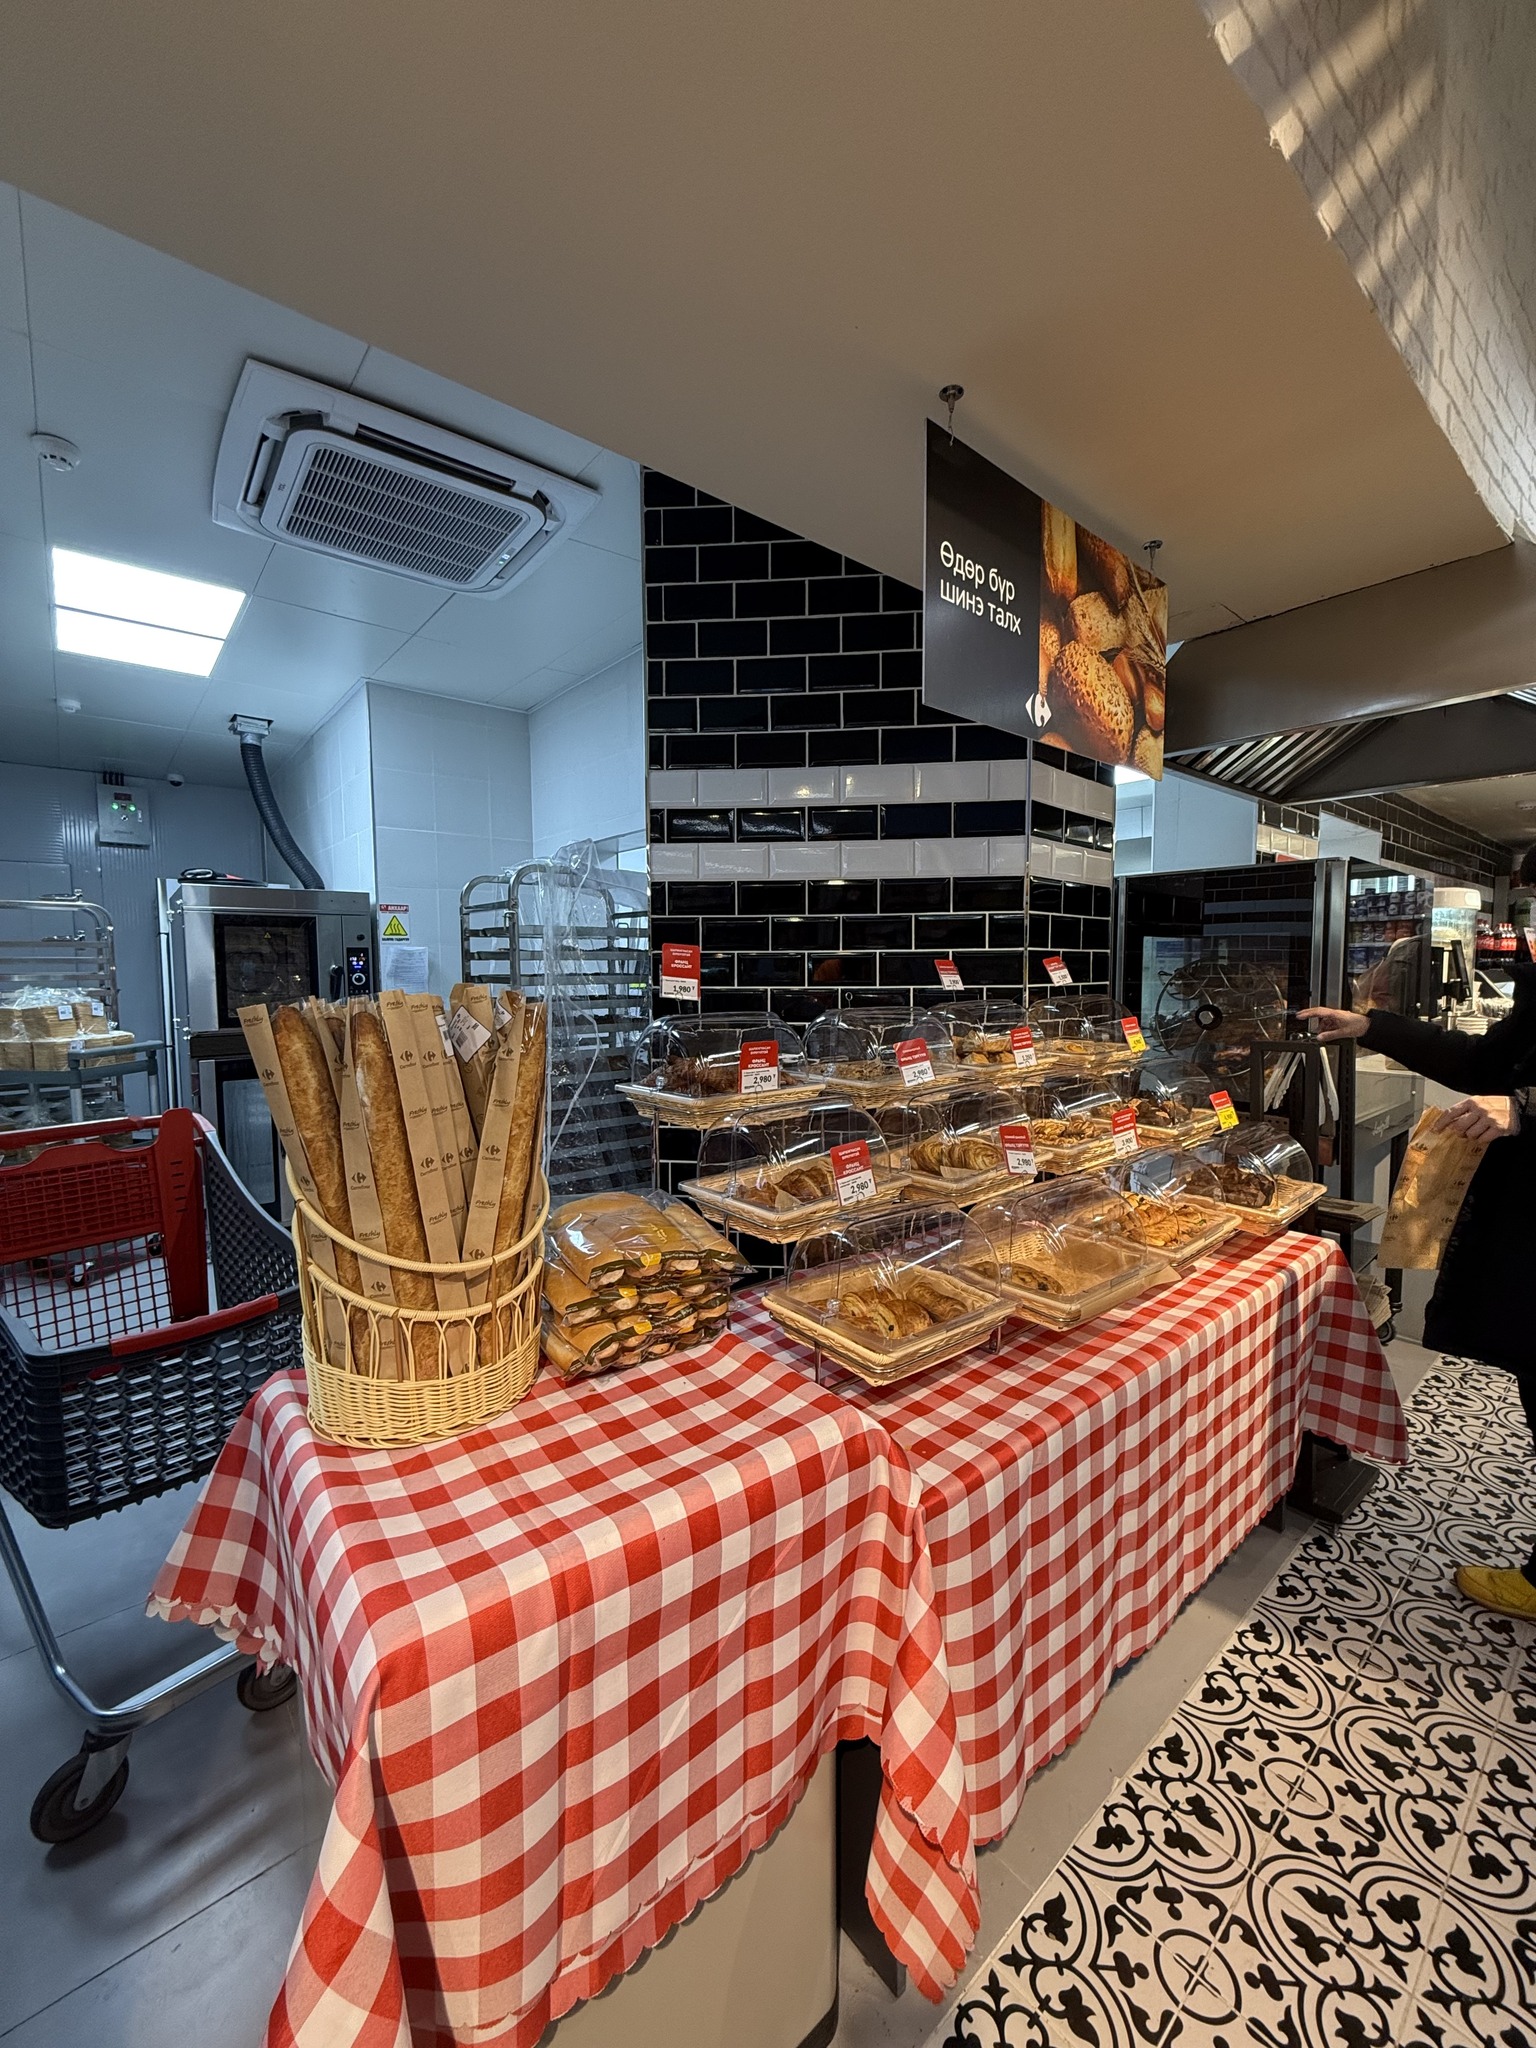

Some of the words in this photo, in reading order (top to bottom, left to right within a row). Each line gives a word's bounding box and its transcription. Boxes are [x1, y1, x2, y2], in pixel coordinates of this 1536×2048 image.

[941, 541, 985, 589] Өдөр
[988, 567, 1016, 605] бүр
[940, 578, 984, 617] шинэ
[988, 602, 1022, 636] талх
[475, 1199, 496, 1209] Freshly
[358, 1230, 381, 1241] Freshly
